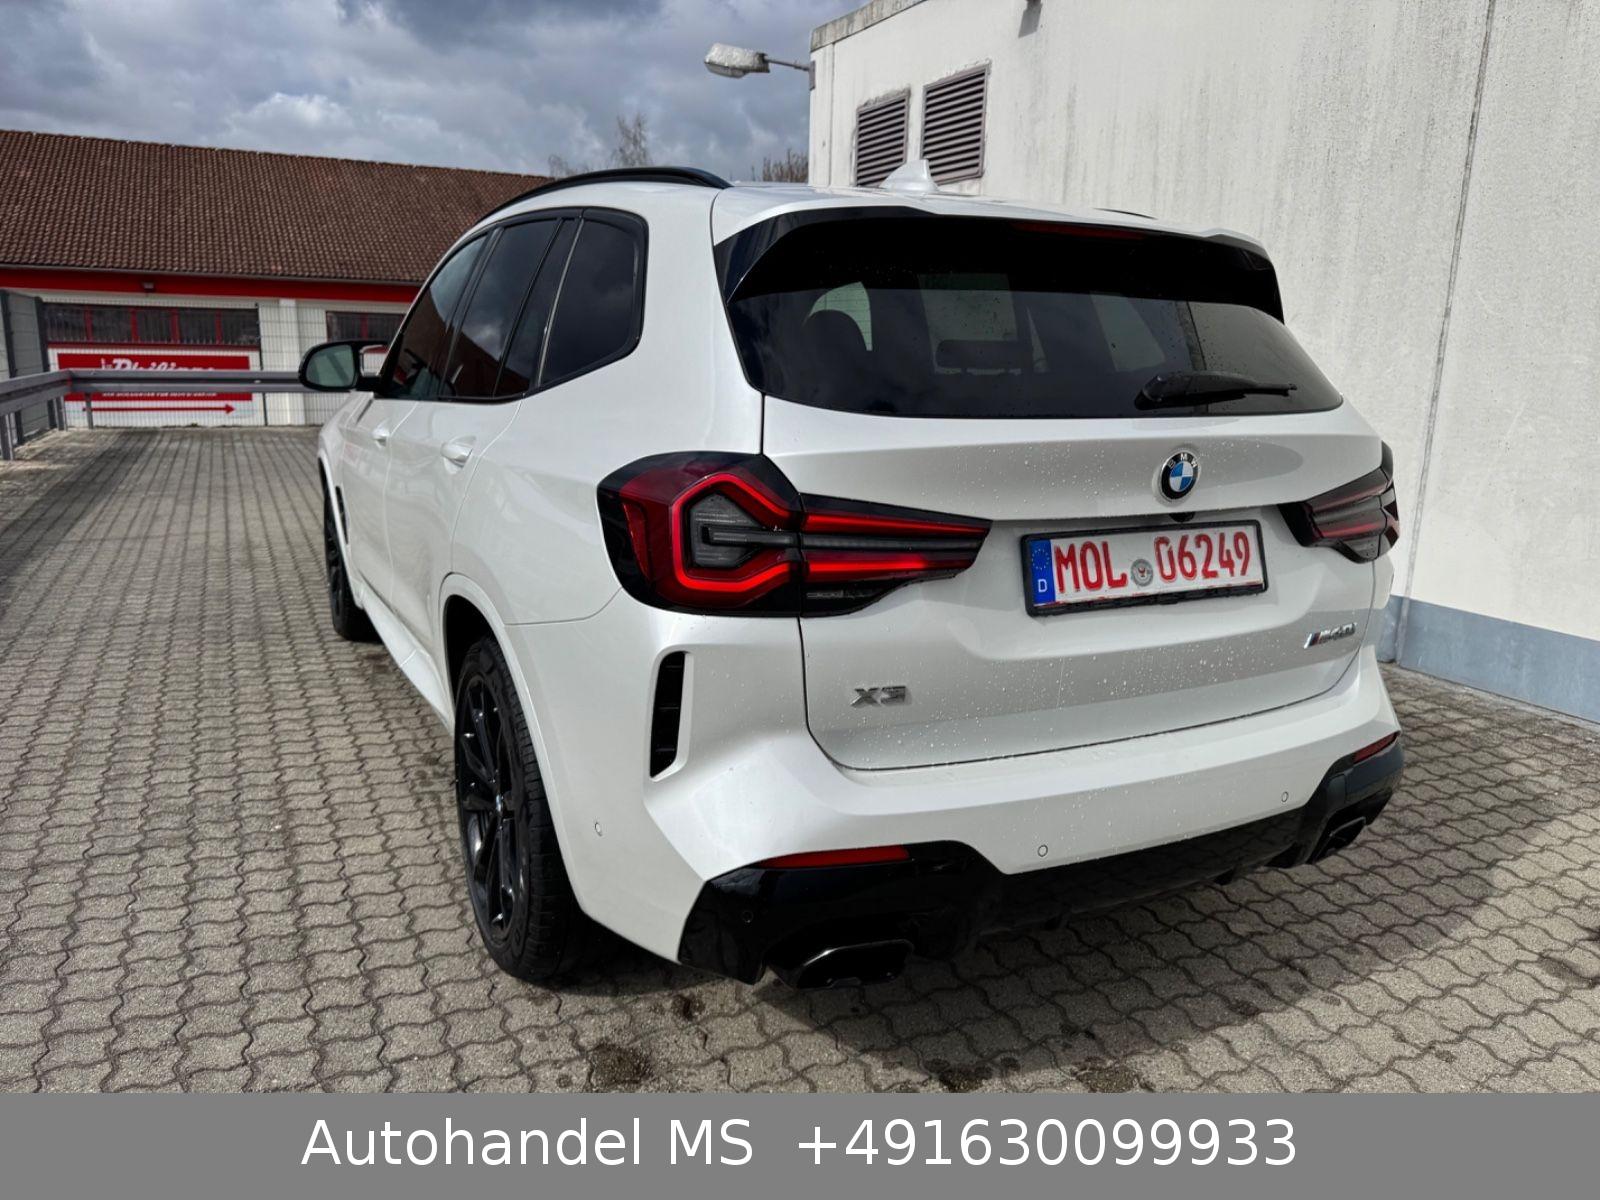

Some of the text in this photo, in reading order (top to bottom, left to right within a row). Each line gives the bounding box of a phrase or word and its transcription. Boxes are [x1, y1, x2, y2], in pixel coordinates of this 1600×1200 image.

[1054, 531, 1250, 593] MOL 06249
[1037, 578, 1048, 593] D
[850, 686, 907, 706] X3
